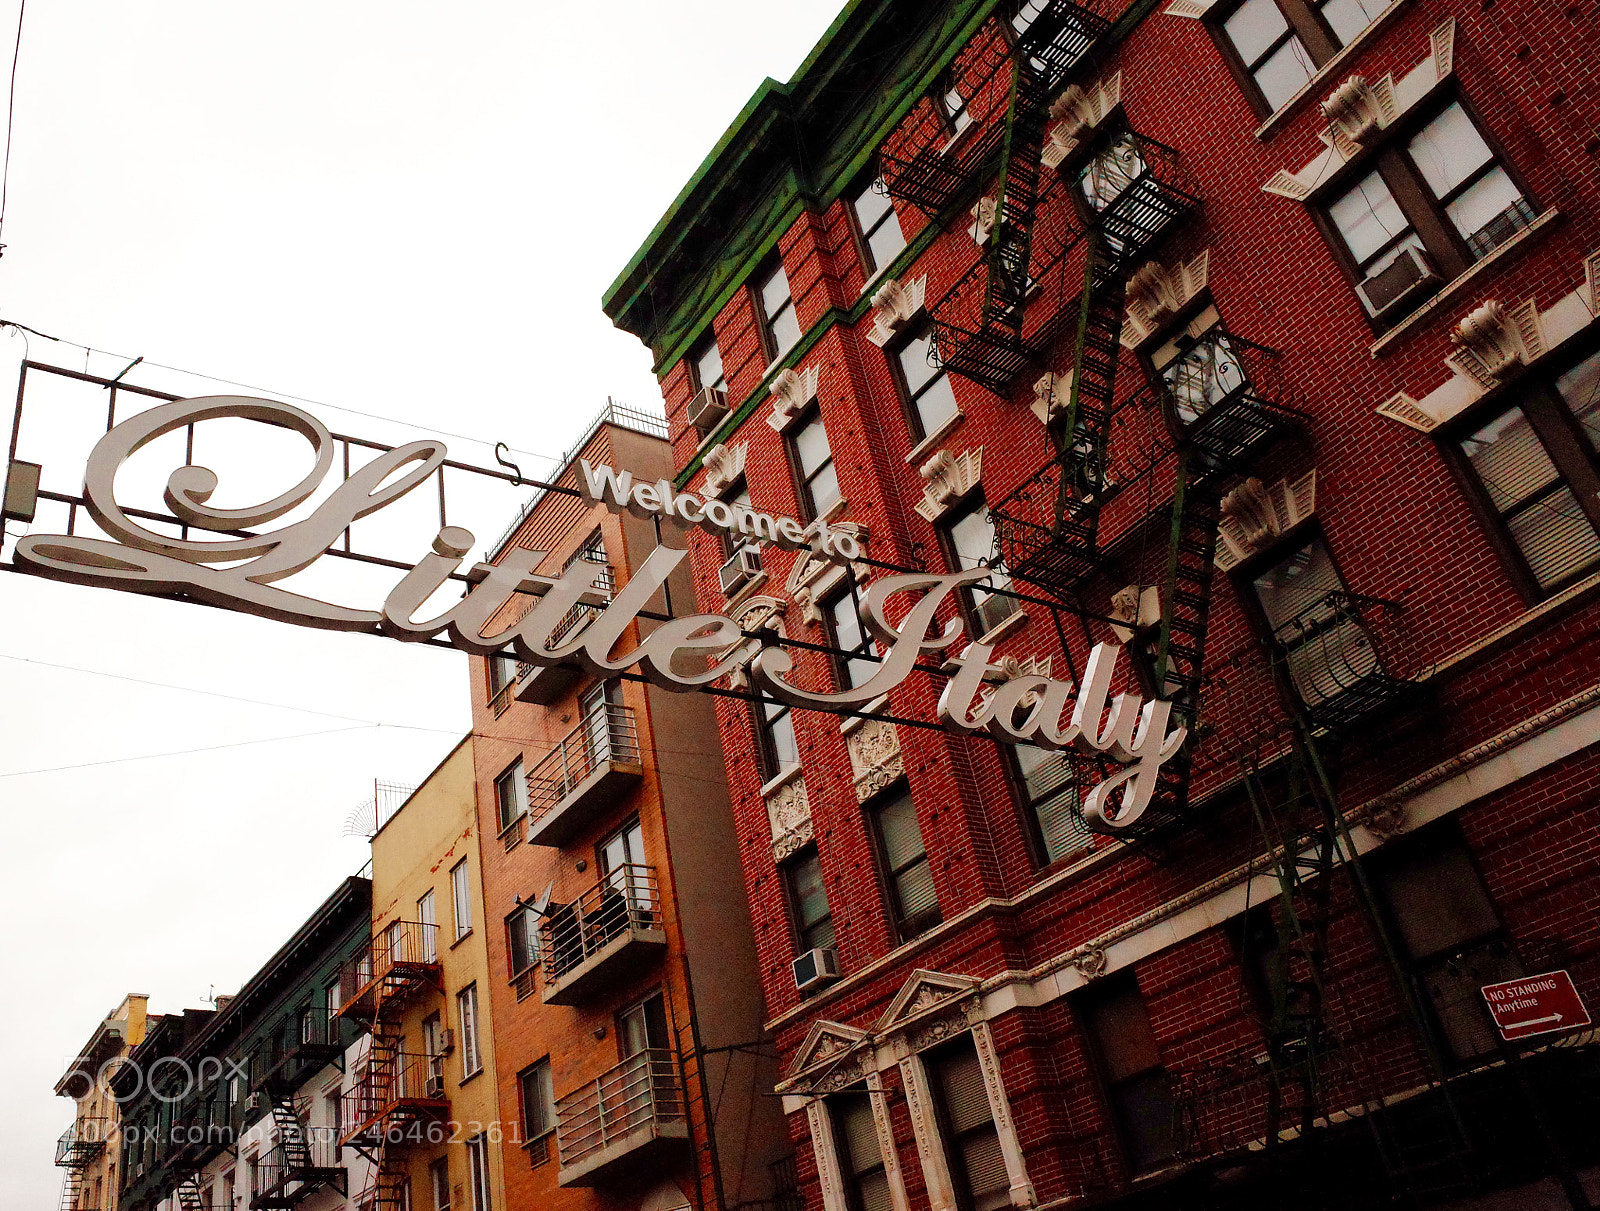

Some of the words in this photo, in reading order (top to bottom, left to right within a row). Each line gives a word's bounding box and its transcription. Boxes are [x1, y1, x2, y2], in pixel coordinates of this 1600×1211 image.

[577, 458, 804, 547] Welcome
[812, 521, 860, 564] to
[13, 394, 759, 692] Little
[751, 566, 1188, 828] Italy
[1490, 991, 1505, 1001] NO
[1506, 980, 1556, 998] STANDING
[1497, 999, 1538, 1013] Anytime
